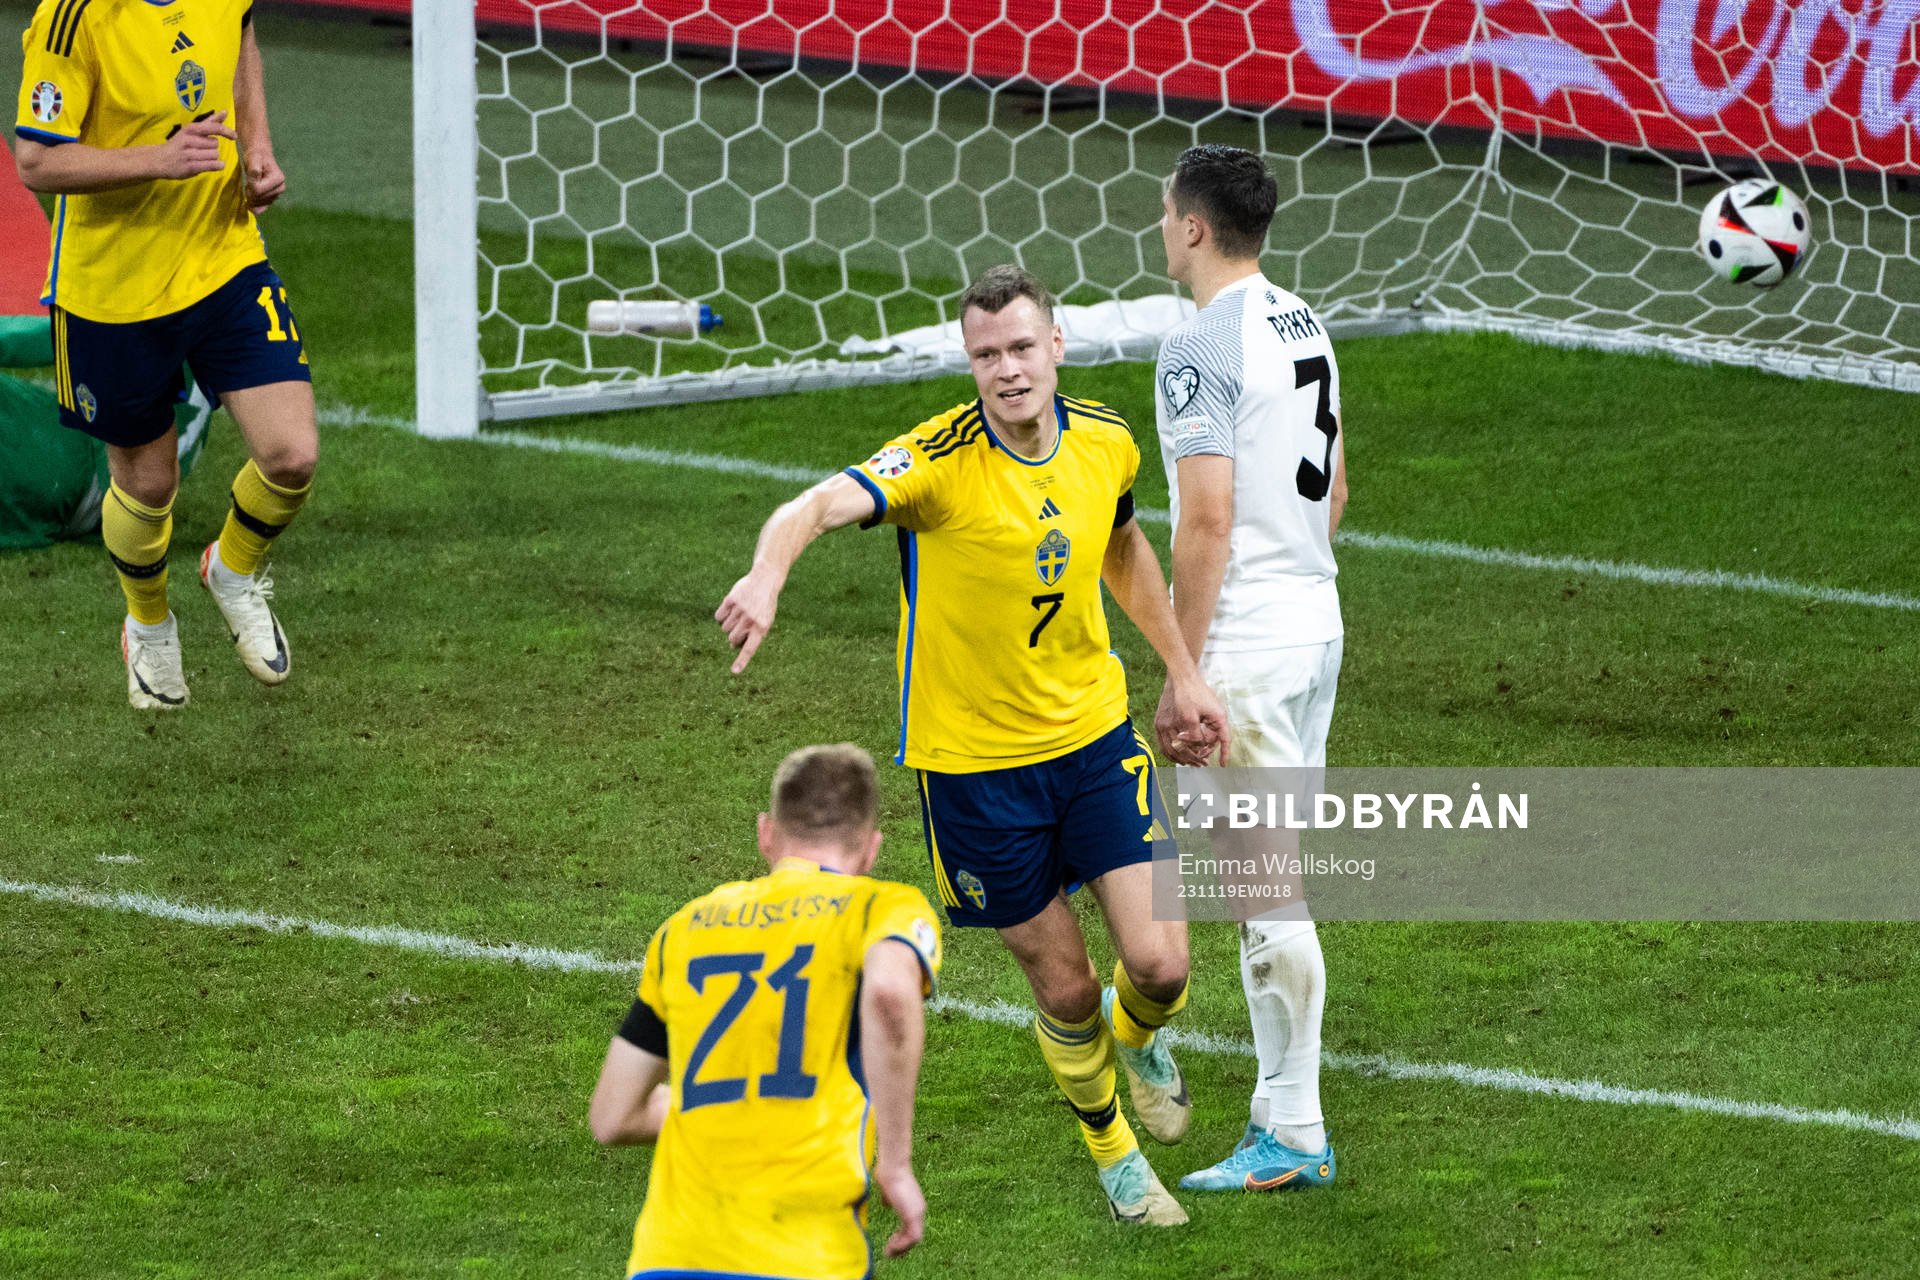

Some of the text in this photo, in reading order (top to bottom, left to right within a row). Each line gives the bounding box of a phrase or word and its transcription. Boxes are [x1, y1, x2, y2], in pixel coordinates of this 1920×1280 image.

[1267, 307, 1321, 343] PIKK
[1293, 355, 1338, 502] 3
[1028, 592, 1065, 649] 7
[1121, 754, 1150, 816] 7
[681, 943, 817, 1112] 21
